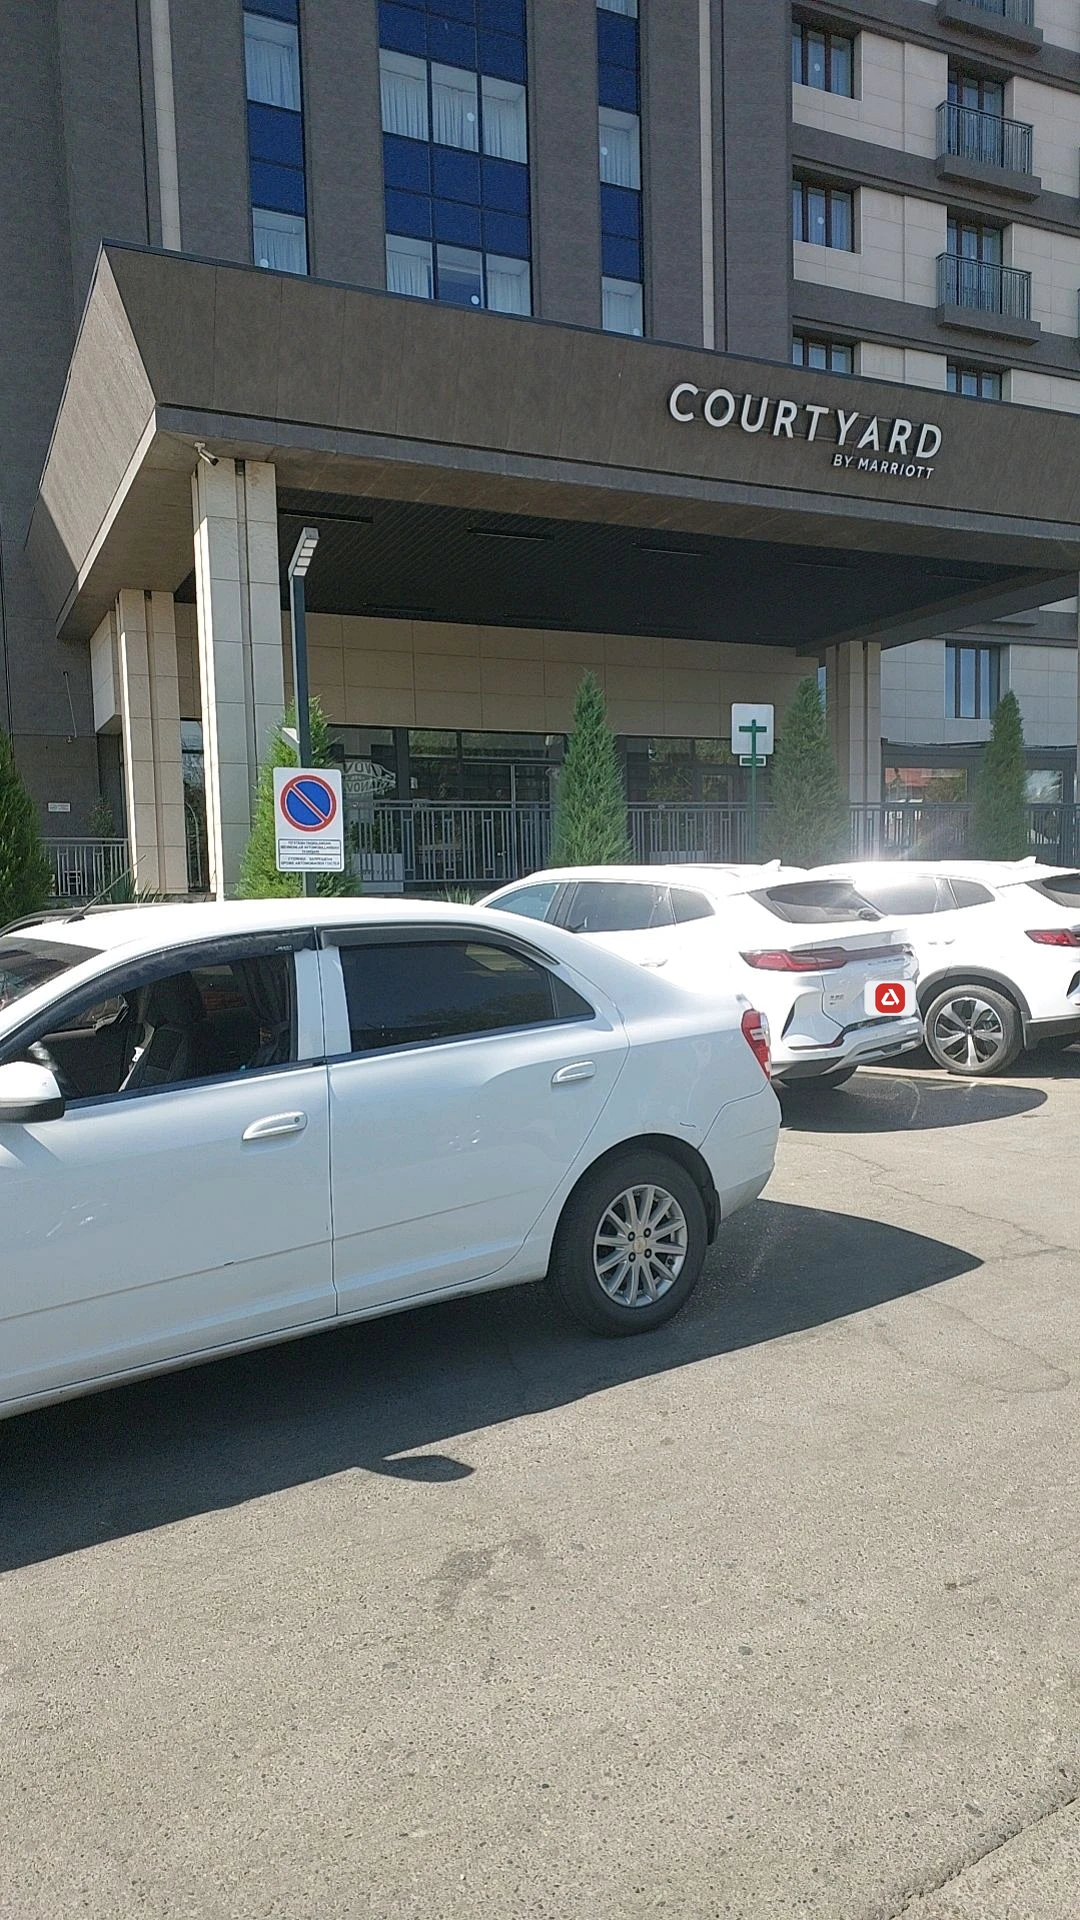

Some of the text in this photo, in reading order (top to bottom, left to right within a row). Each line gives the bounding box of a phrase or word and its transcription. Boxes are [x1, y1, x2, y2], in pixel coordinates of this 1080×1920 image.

[668, 382, 943, 459] COURTYARD
[832, 454, 935, 480] BY MARRIOTT
